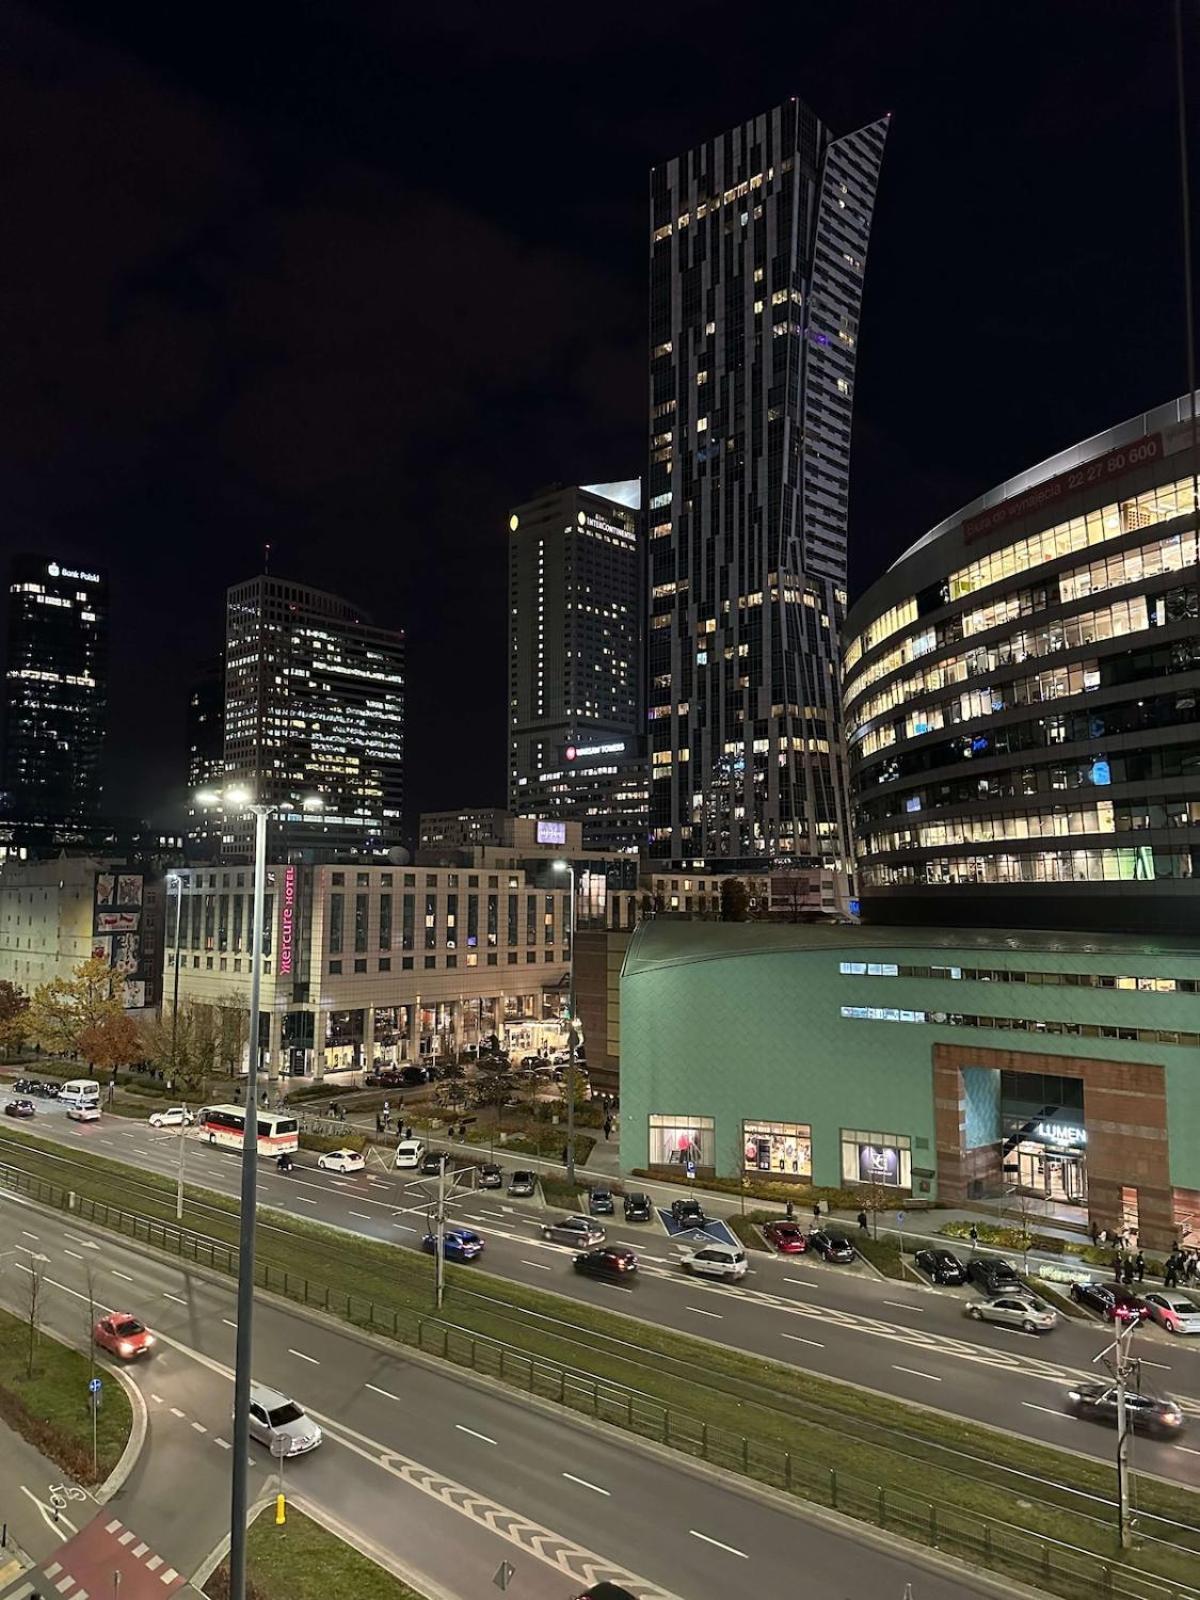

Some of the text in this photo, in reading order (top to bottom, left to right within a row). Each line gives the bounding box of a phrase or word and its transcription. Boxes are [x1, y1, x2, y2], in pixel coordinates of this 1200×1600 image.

[1067, 472, 1085, 489] 22
[1087, 463, 1104, 481] 27
[1107, 454, 1126, 473] 80
[1128, 441, 1157, 463] 600
[286, 867, 295, 905] HOTEL
[1038, 1123, 1087, 1142] LUMEN
